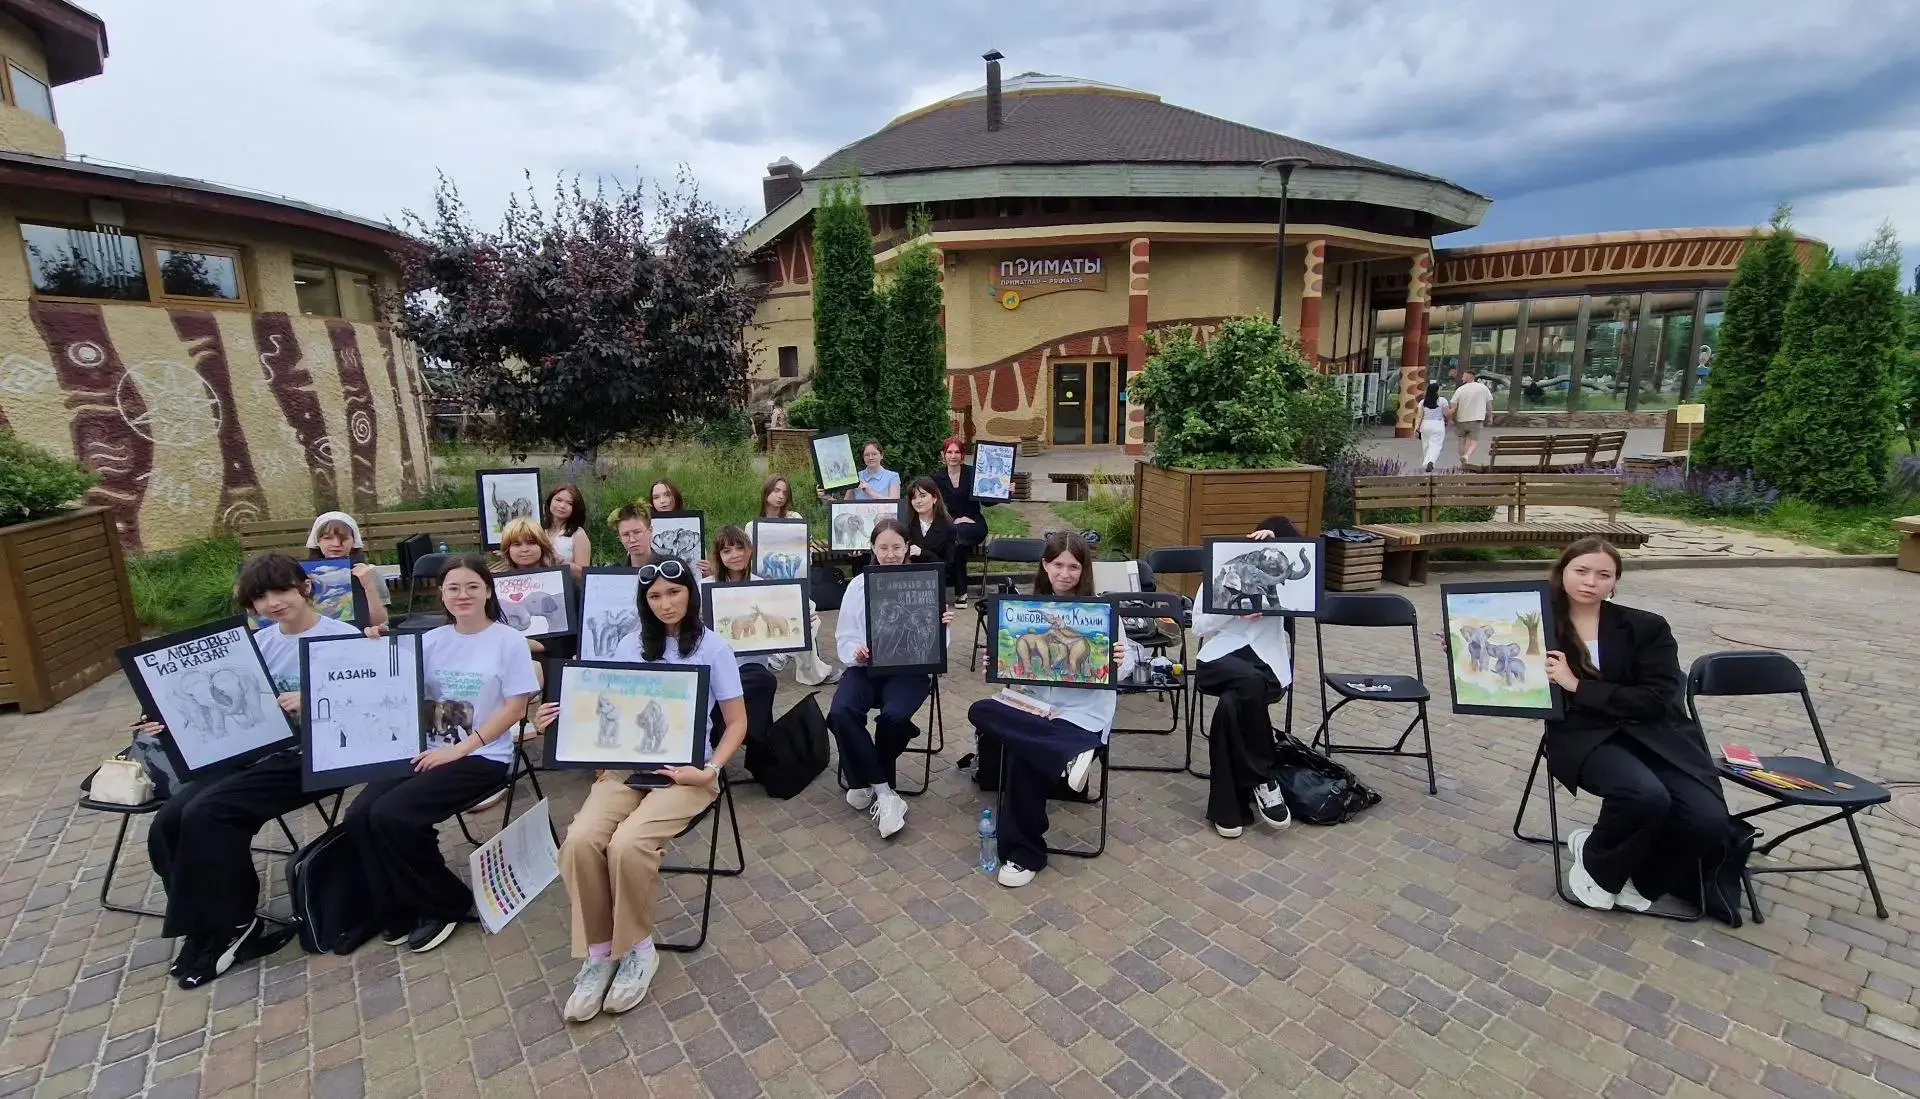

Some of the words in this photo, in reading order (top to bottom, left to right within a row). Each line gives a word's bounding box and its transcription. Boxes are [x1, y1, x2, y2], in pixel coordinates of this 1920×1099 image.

[1001, 258, 1101, 277] ПРИМАТЫ
[143, 654, 158, 667] С
[167, 630, 240, 660] ЛЮБОВЬЮ
[156, 661, 178, 676] ИЗ
[328, 668, 377, 681] КАЗАНЬ
